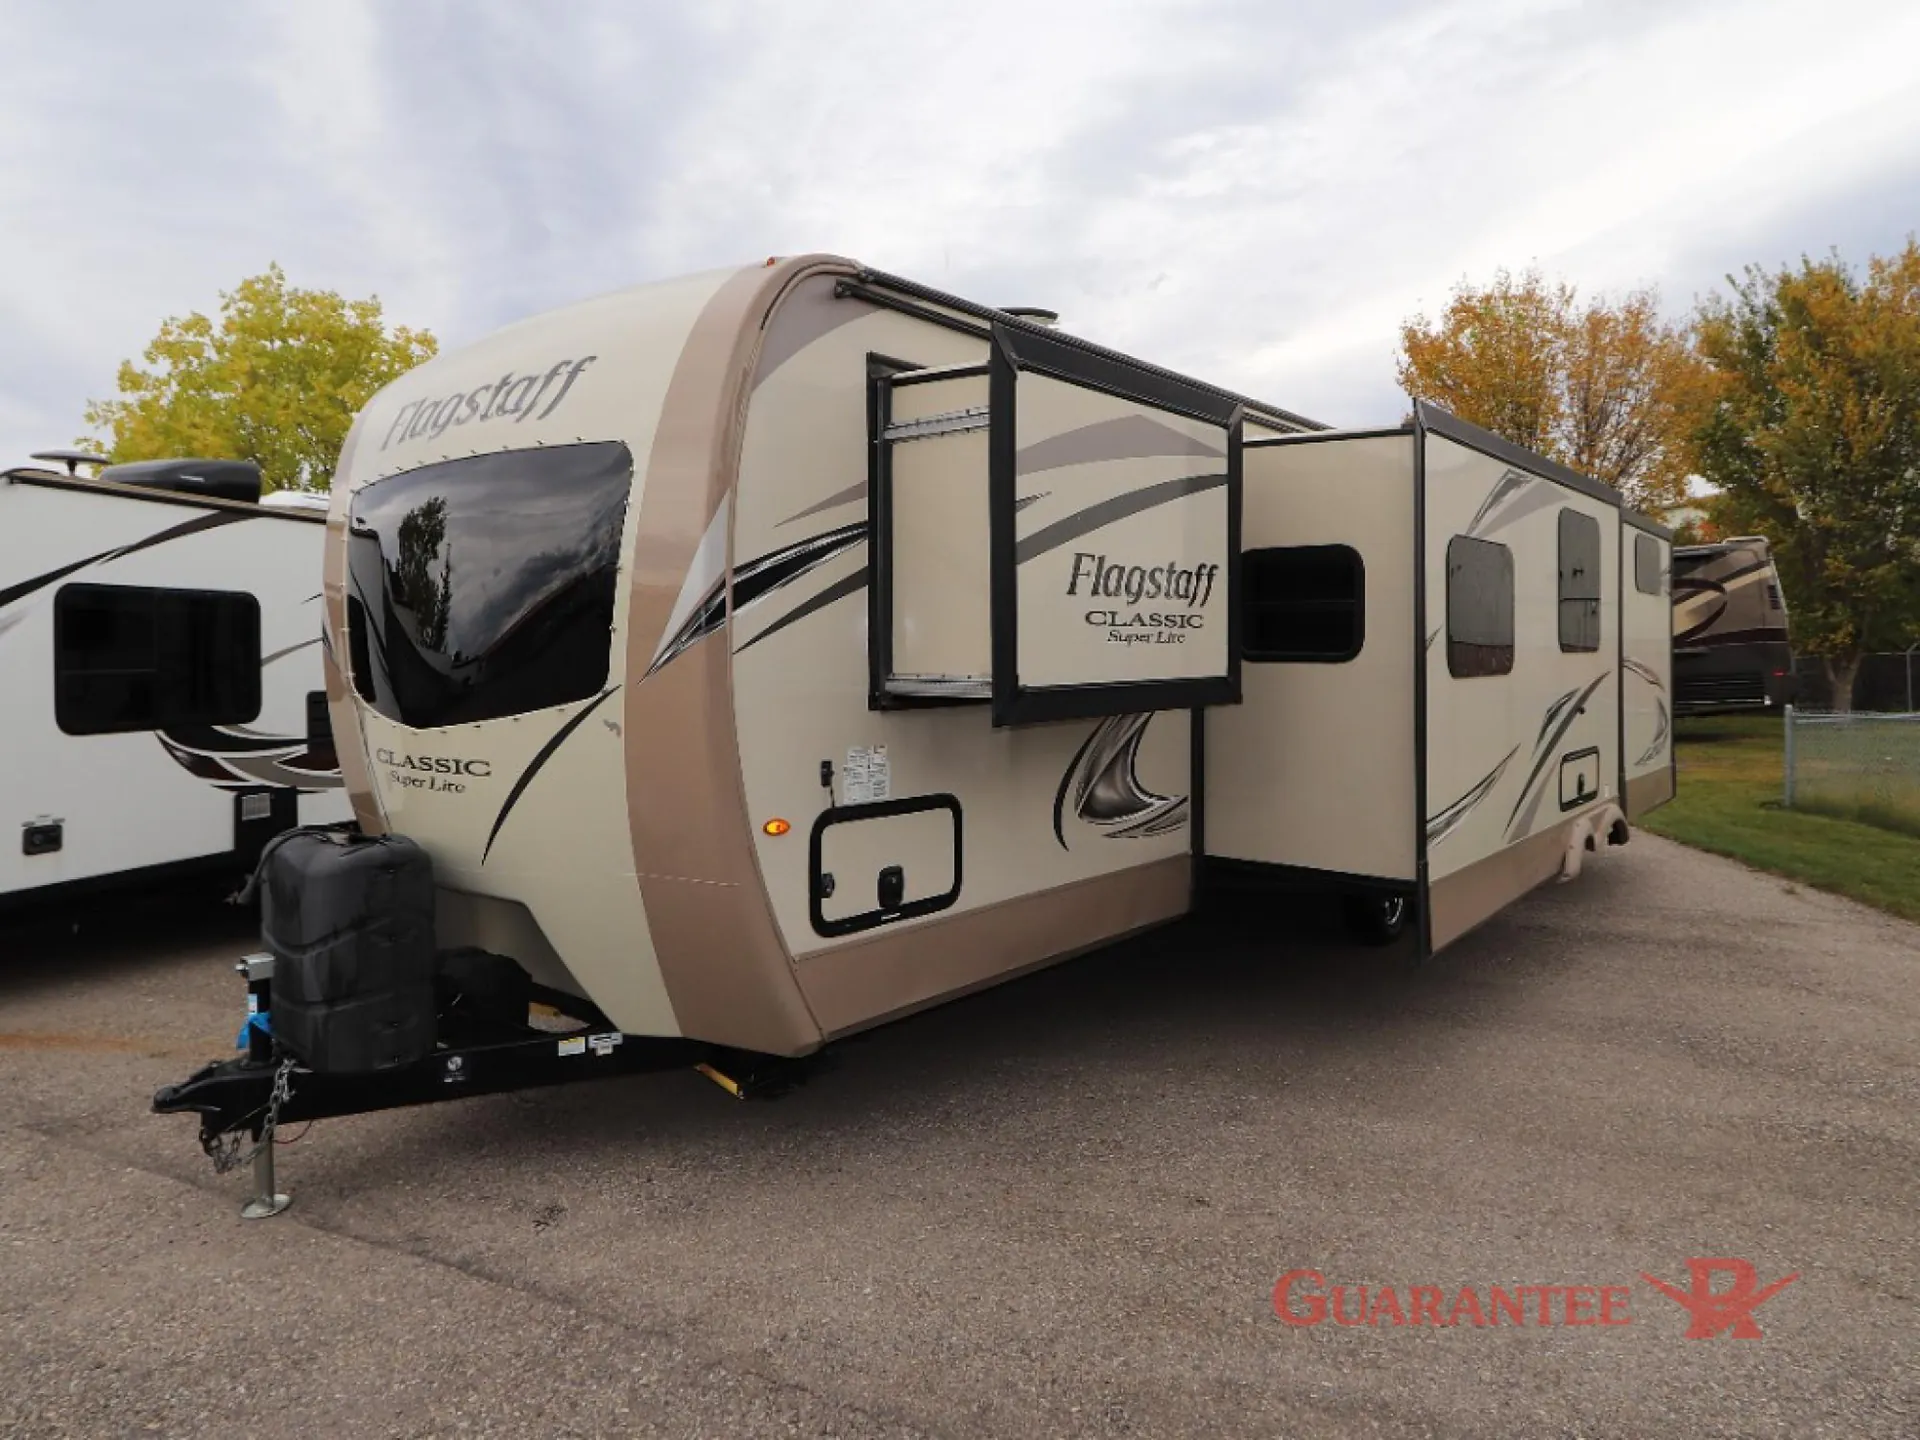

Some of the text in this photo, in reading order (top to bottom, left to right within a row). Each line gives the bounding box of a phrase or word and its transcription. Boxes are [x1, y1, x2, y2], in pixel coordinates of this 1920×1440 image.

[380, 355, 597, 451] Flagstaff
[1066, 553, 1219, 607] Flagstaff
[1085, 610, 1205, 629] CLASSIC
[1107, 630, 1187, 646] Super Lite
[376, 747, 492, 777] CLASSIC
[390, 770, 466, 793] Super Lite
